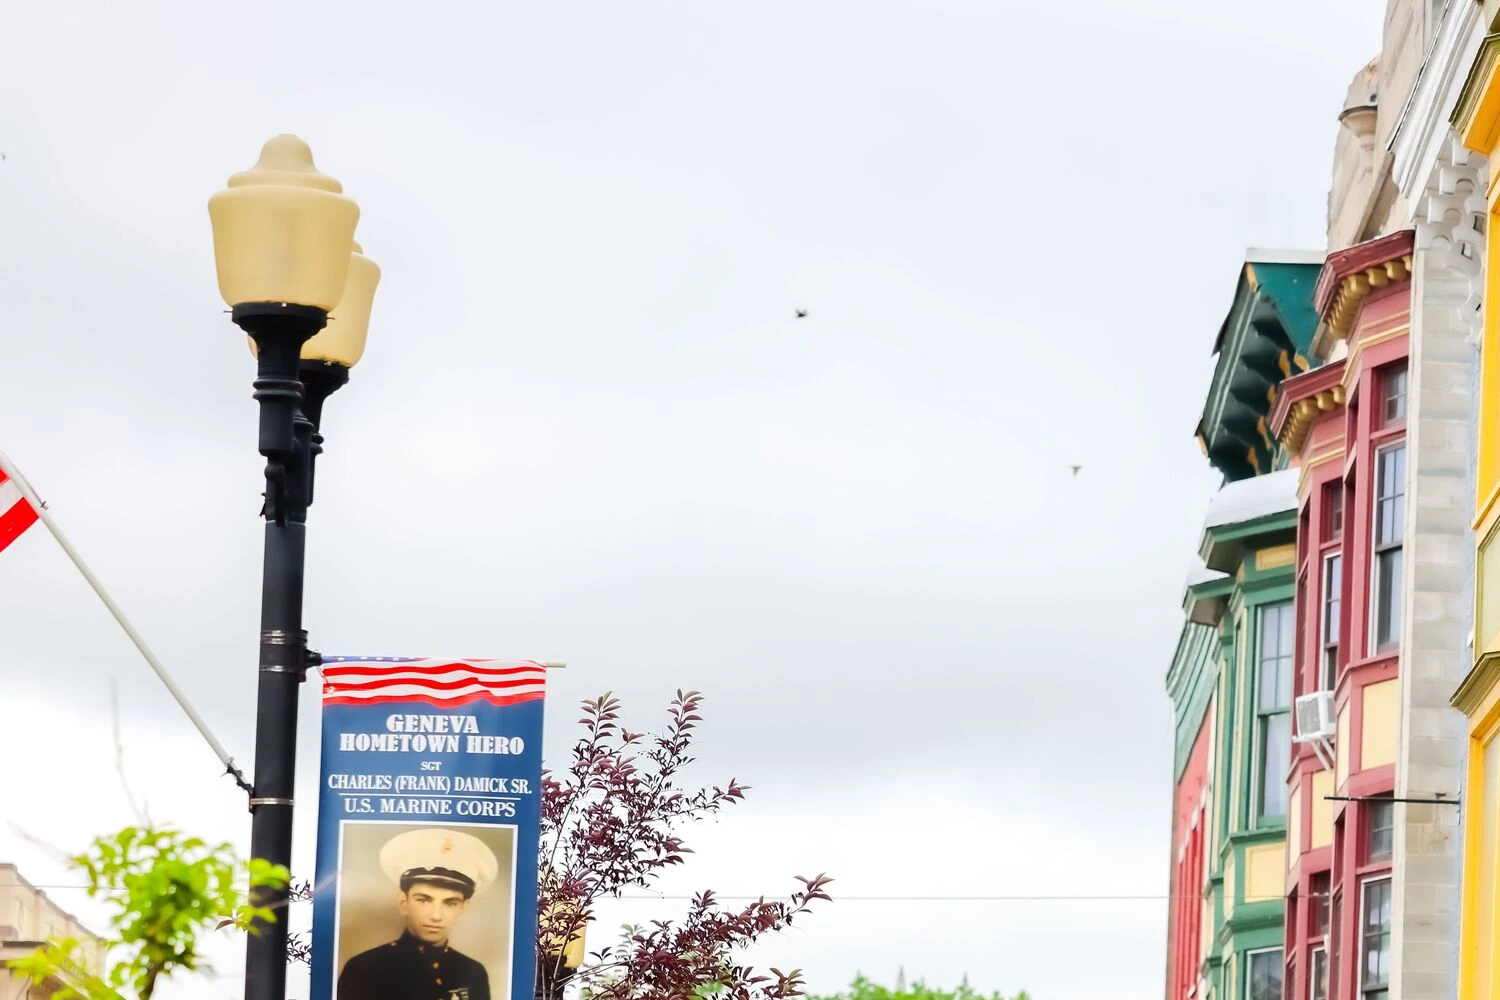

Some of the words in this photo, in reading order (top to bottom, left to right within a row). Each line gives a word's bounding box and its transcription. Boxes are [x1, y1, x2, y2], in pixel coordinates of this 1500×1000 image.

[386, 714, 480, 734] GENEVA
[339, 733, 460, 753] HOMETOWN
[466, 736, 525, 756] HERO
[420, 761, 442, 772] SGT
[328, 774, 392, 791] CHARLES
[395, 775, 451, 795] (FRANK)
[454, 777, 508, 795] DAMICK
[511, 779, 533, 795] SR.
[343, 798, 375, 814] U.S.
[380, 799, 452, 816] MARINE
[455, 800, 516, 818] CORPS
